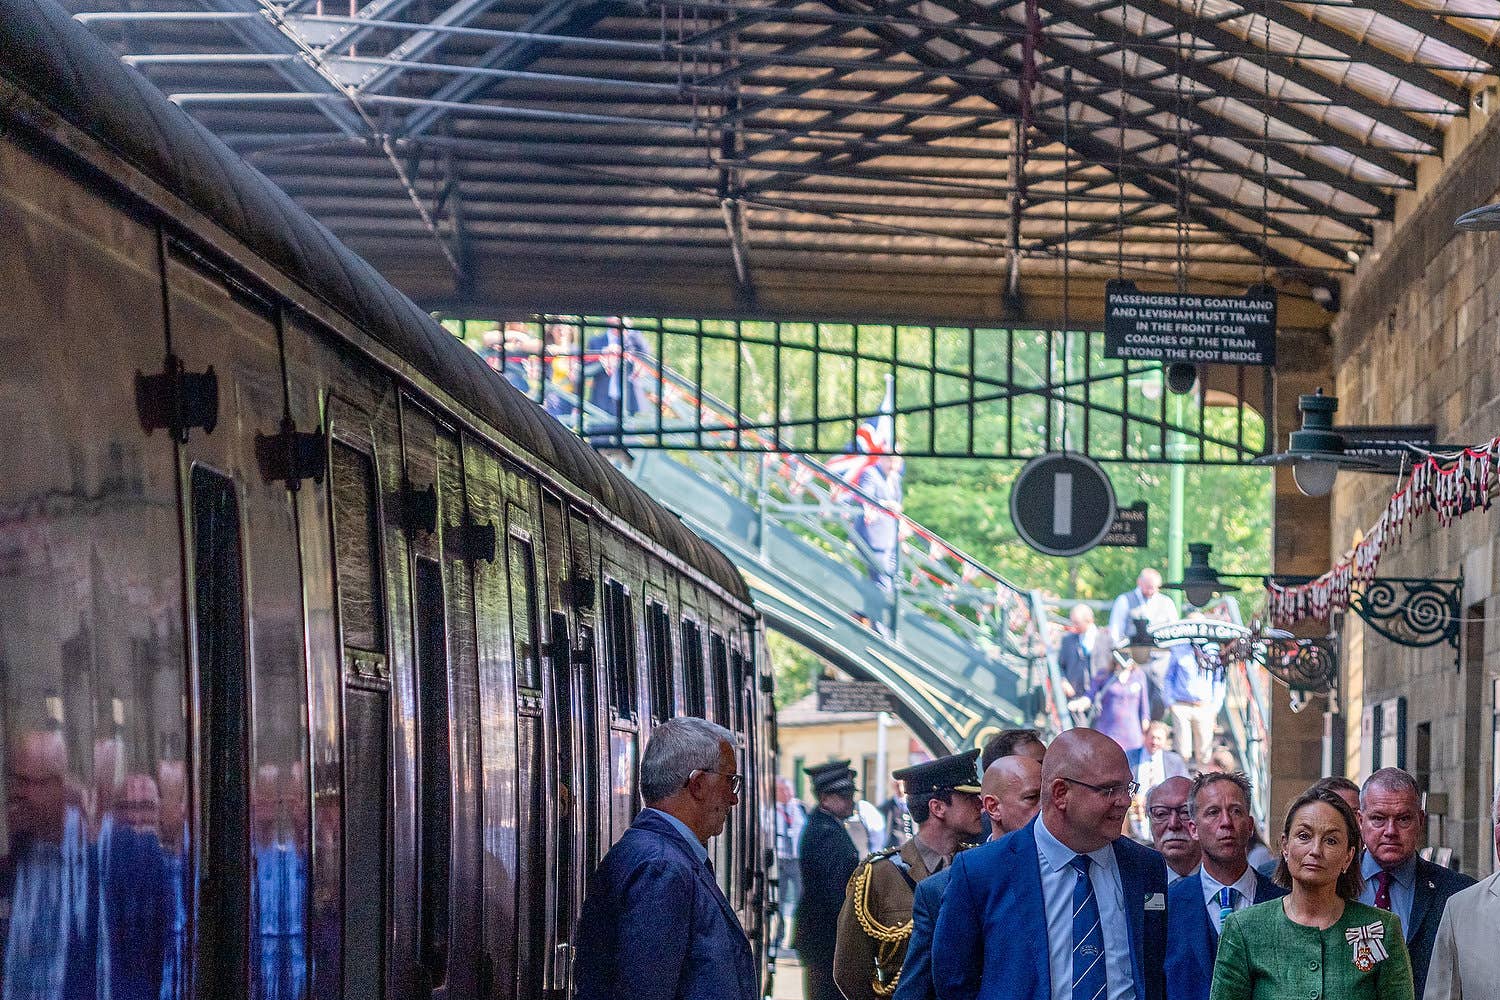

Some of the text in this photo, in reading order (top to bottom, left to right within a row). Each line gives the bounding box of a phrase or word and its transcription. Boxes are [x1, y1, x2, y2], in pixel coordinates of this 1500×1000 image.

[1109, 294, 1273, 310] PASSENGERS FOR GOATHLAND
[1112, 307, 1270, 323] AND LEVISHAM MUST TRAVEL
[1136, 322, 1246, 335] IN THE FRONT FOUR
[1124, 334, 1256, 348] COACHES OF THE TRAIN
[1117, 346, 1262, 361] BEYOND THE FOOT BRIDGE
